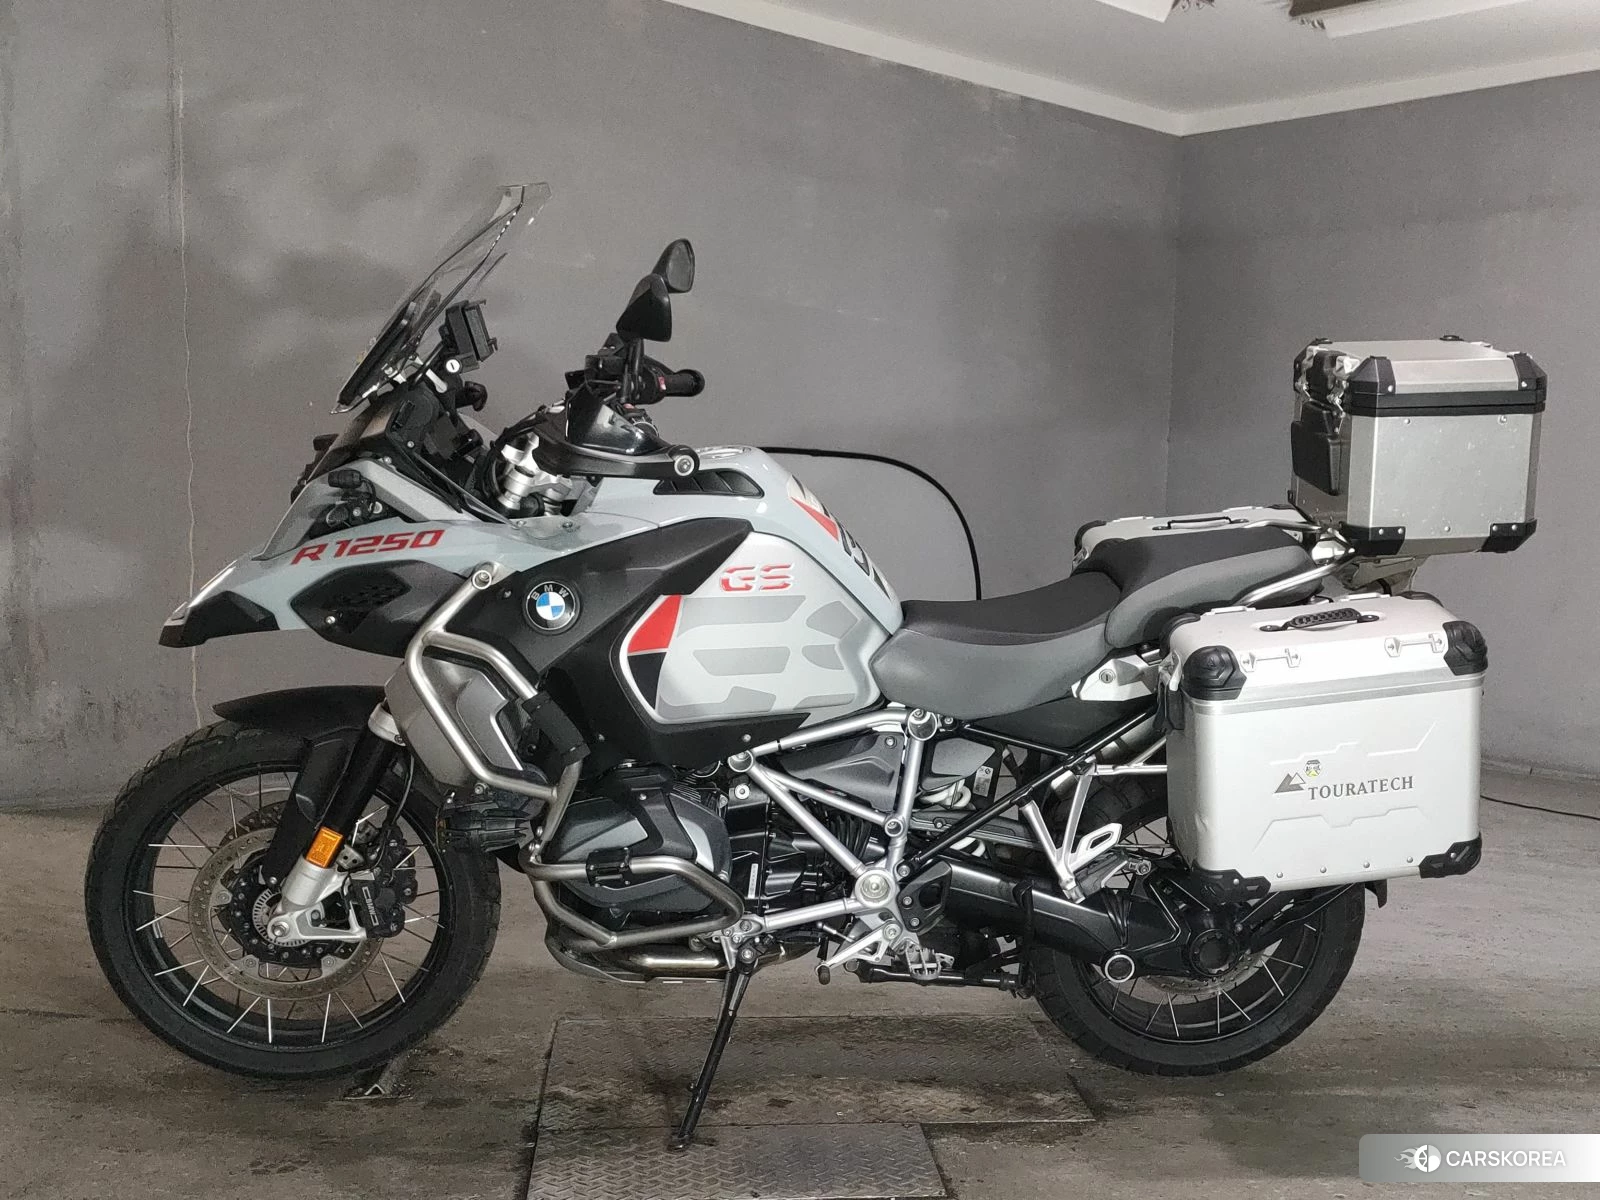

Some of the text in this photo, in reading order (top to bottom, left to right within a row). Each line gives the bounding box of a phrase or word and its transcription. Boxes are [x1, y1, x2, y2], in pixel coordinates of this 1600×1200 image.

[290, 529, 445, 565] R 1250
[720, 564, 792, 592] GS
[530, 584, 569, 600] BMW
[1307, 775, 1414, 801] TOURATECH
